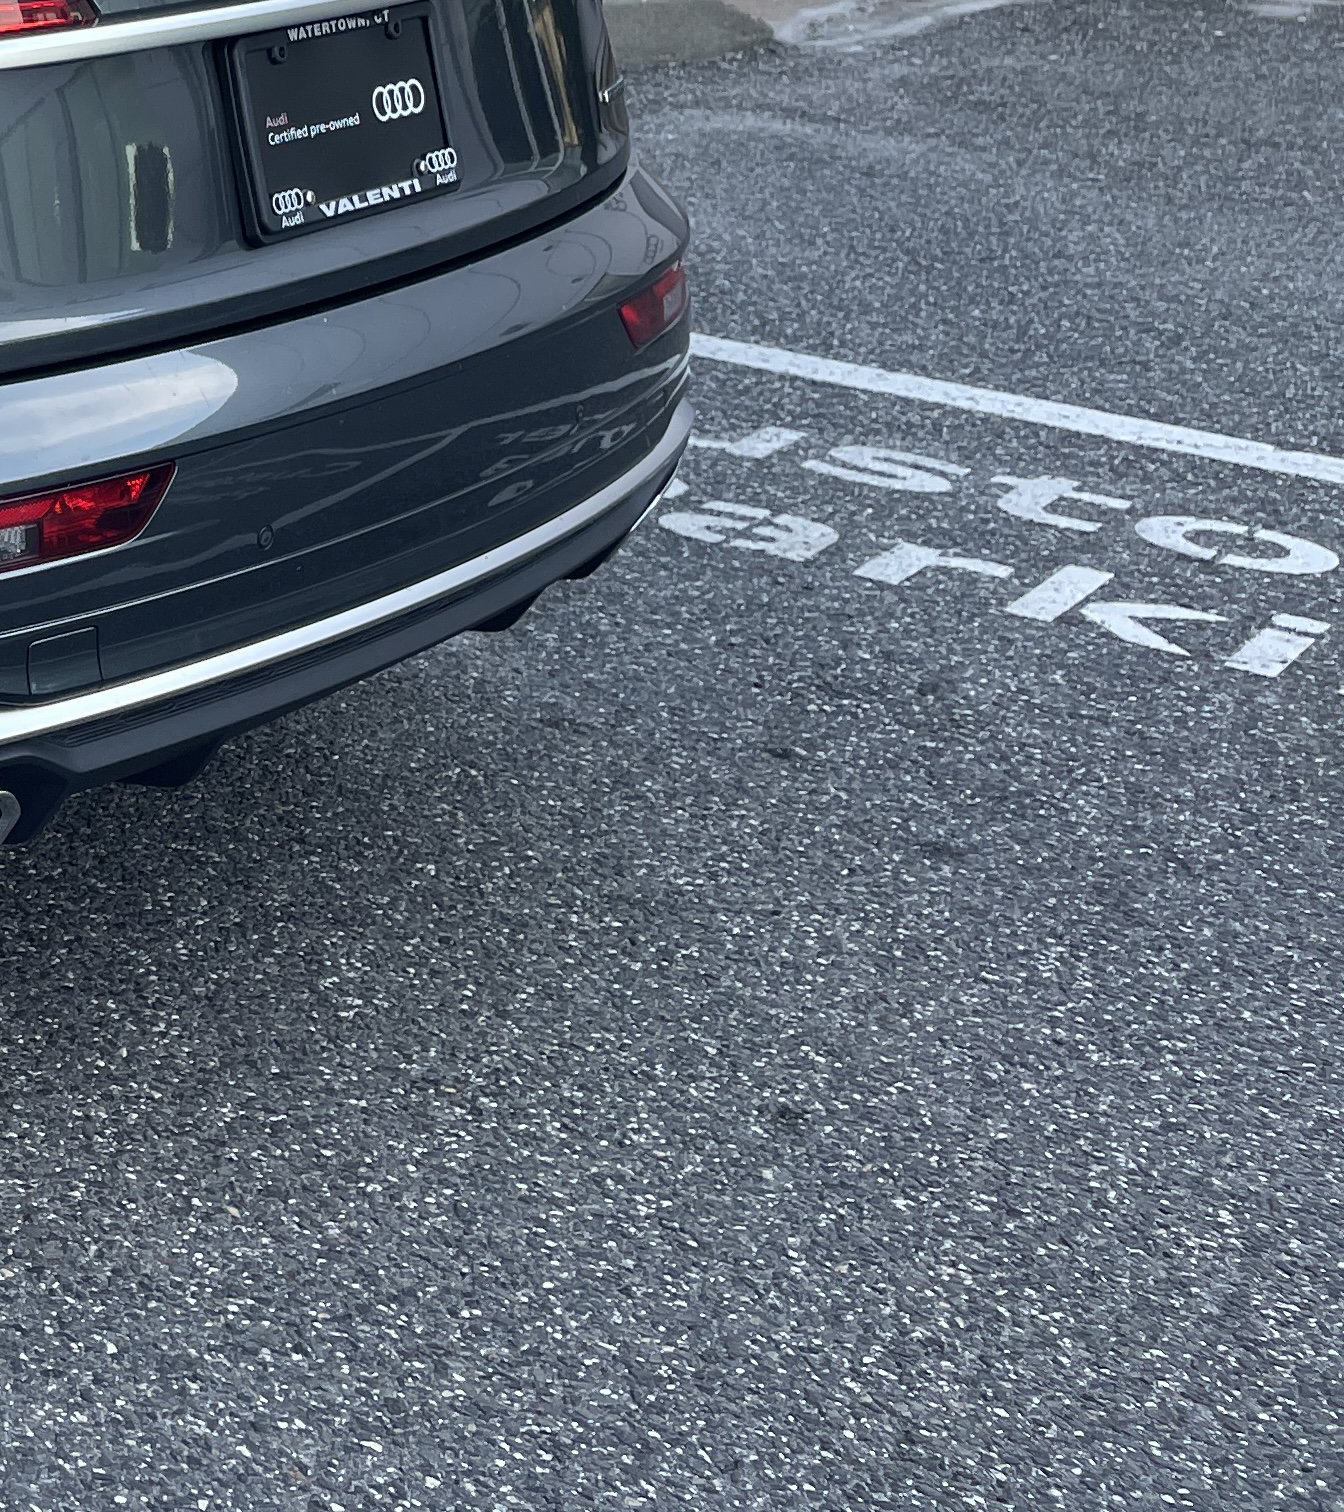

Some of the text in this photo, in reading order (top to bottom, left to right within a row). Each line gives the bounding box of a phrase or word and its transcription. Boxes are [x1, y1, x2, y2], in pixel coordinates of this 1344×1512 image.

[287, 17, 369, 41] WATERTOWN,
[266, 112, 288, 129] Audi
[268, 113, 360, 146] Certified pre-owned
[436, 170, 458, 186] Audi
[319, 178, 421, 216] VALENTI
[281, 211, 305, 229] Audi
[658, 479, 1331, 678] arki
